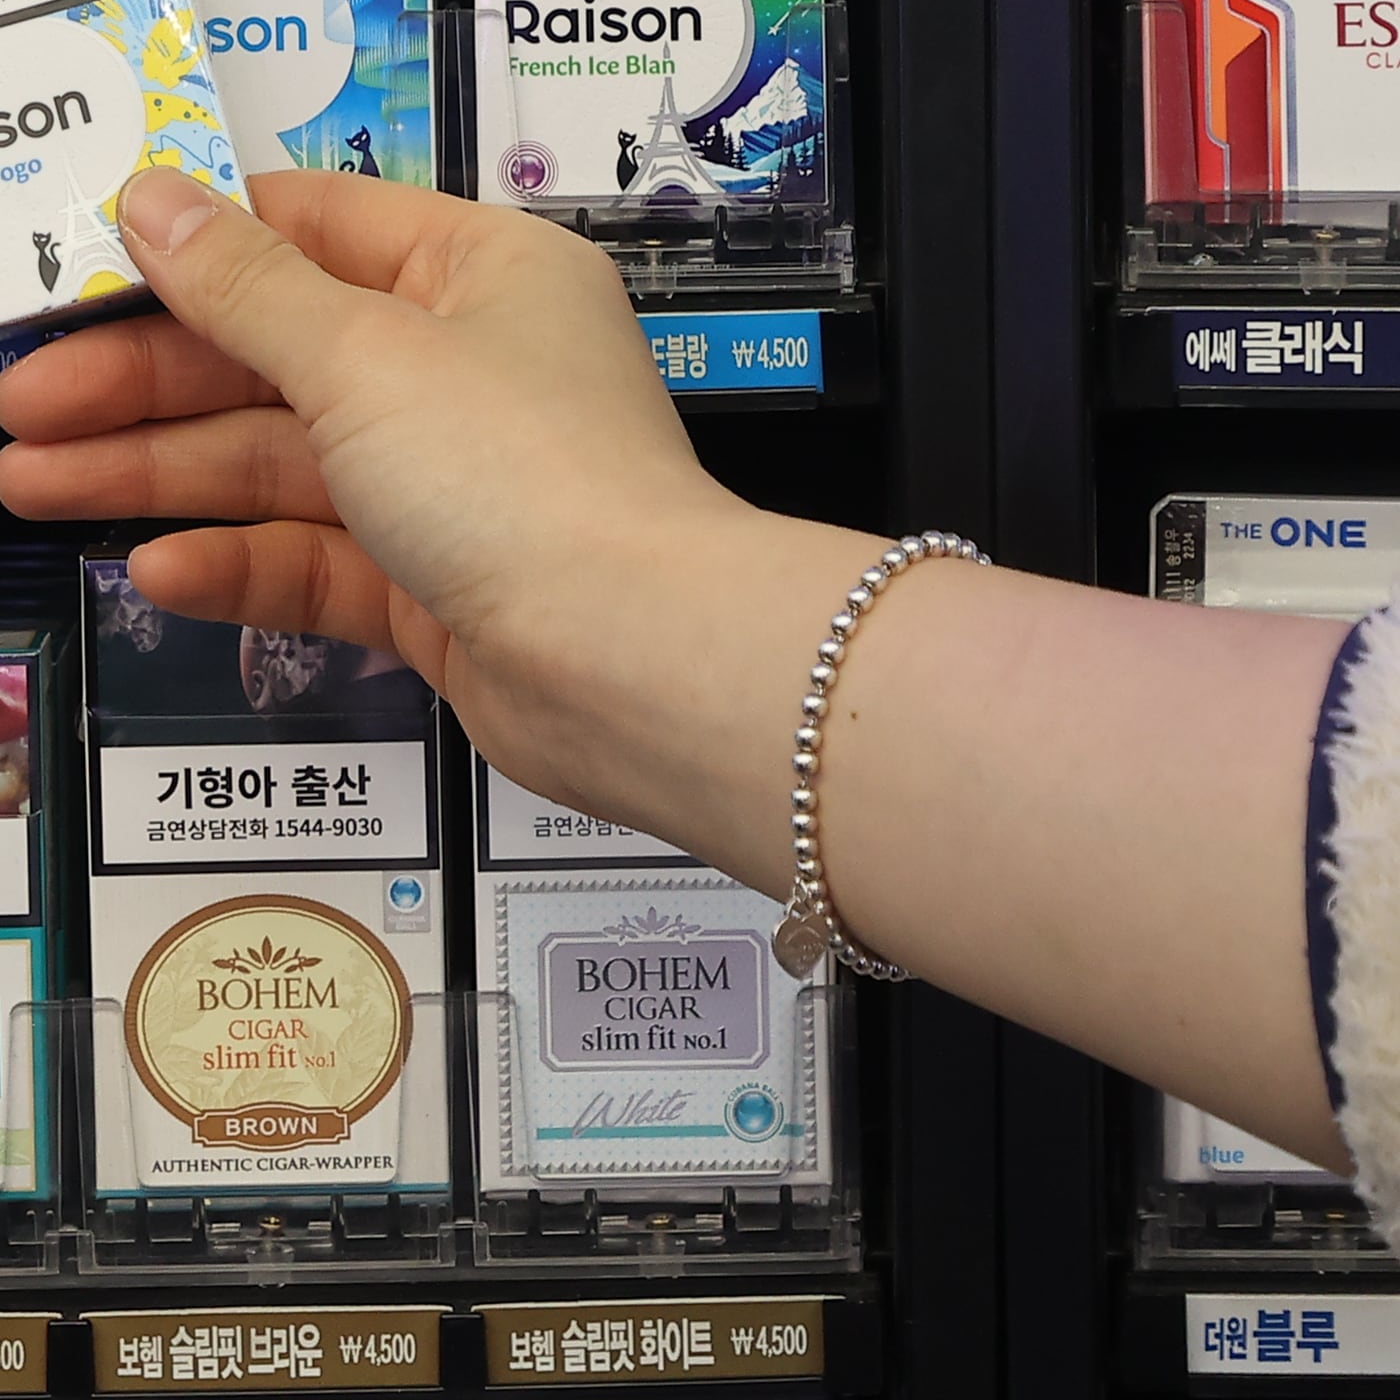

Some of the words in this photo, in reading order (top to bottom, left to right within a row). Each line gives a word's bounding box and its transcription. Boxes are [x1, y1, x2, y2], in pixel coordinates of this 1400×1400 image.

[509, 51, 581, 76] French
[589, 56, 619, 75] Ice
[626, 50, 675, 74] Blan
[1186, 329, 1235, 371] 에쎄
[1242, 321, 1362, 374] 클래식
[1220, 523, 1262, 539] THE
[1271, 517, 1366, 548] ONE
[158, 766, 277, 809] 기형아
[292, 764, 371, 807] 출산
[576, 956, 730, 992] BOHEM
[197, 978, 339, 1011] BOHEM
[228, 1019, 309, 1040] CIGAR
[204, 1045, 260, 1070] slim
[268, 1043, 296, 1068] fit
[226, 1117, 316, 1135] BROWN
[152, 1159, 252, 1173] AUTHENTIC
[257, 1156, 393, 1171] CIGAR-WRAPPER
[1198, 1142, 1244, 1168] blue
[510, 1330, 554, 1371] 보헴
[561, 1319, 634, 1372] 슬림핏
[640, 1318, 714, 1370] 화이트
[731, 1325, 806, 1357] ₩4,500
[1205, 1317, 1247, 1360] 더원
[1253, 1310, 1339, 1363] 블루
